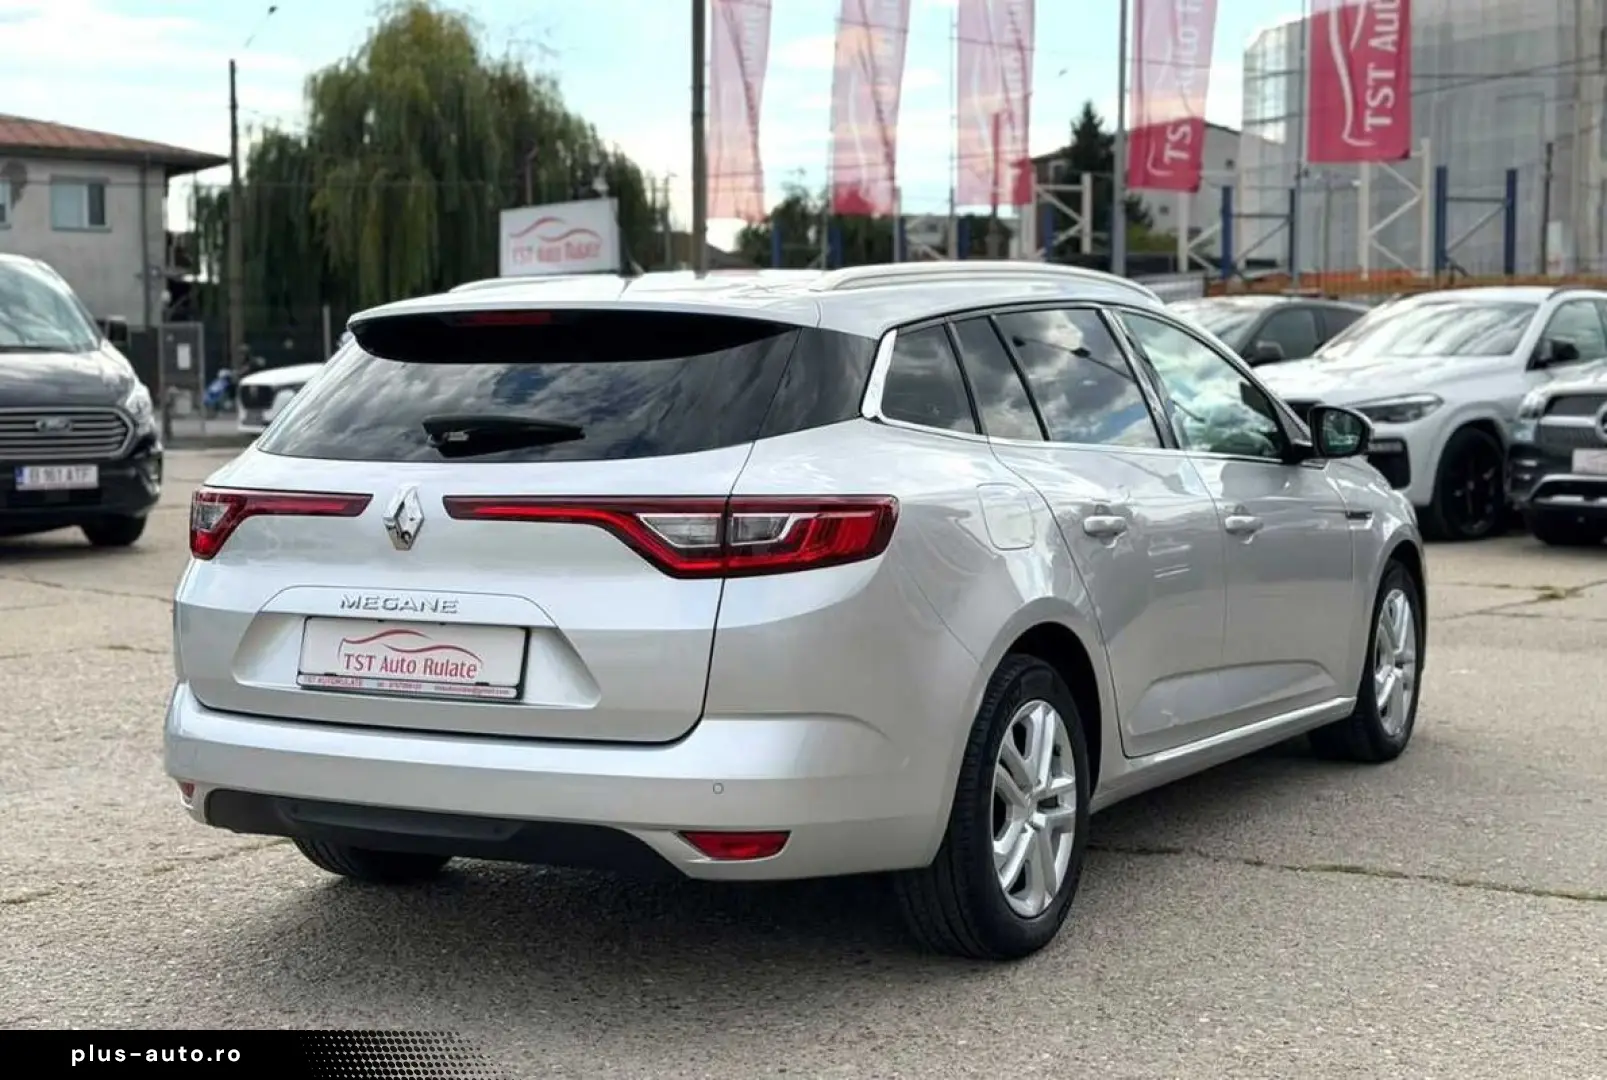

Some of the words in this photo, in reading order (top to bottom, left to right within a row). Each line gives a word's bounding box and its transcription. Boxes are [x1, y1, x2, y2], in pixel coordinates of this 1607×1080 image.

[1364, 61, 1396, 133] TST
[340, 594, 460, 614] MEGANE
[344, 652, 377, 672] TST
[379, 655, 417, 675] Auto
[423, 658, 477, 680] Rulate
